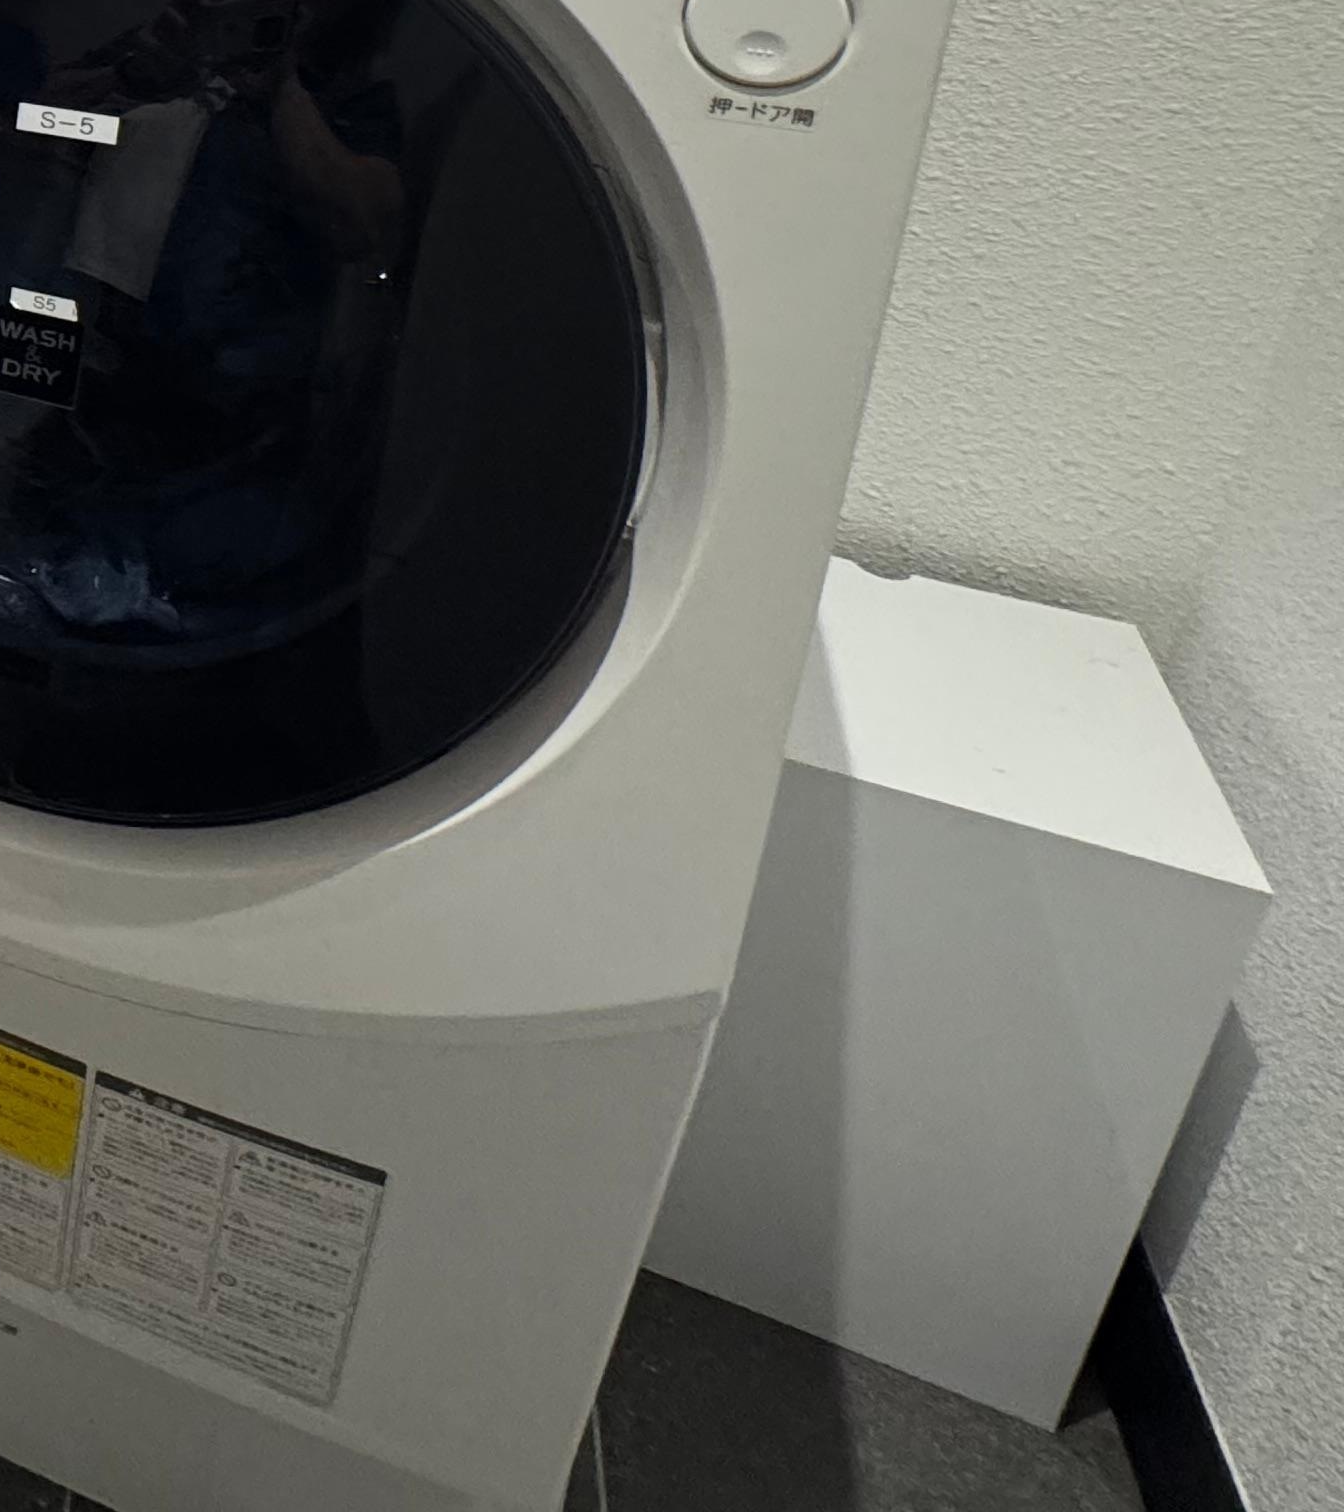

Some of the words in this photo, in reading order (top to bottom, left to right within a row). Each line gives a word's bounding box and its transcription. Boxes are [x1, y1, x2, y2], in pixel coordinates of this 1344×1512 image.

[40, 110, 95, 136] S-5
[33, 295, 57, 312] S5
[0, 318, 76, 352] WASH
[2, 357, 61, 386] DRY
